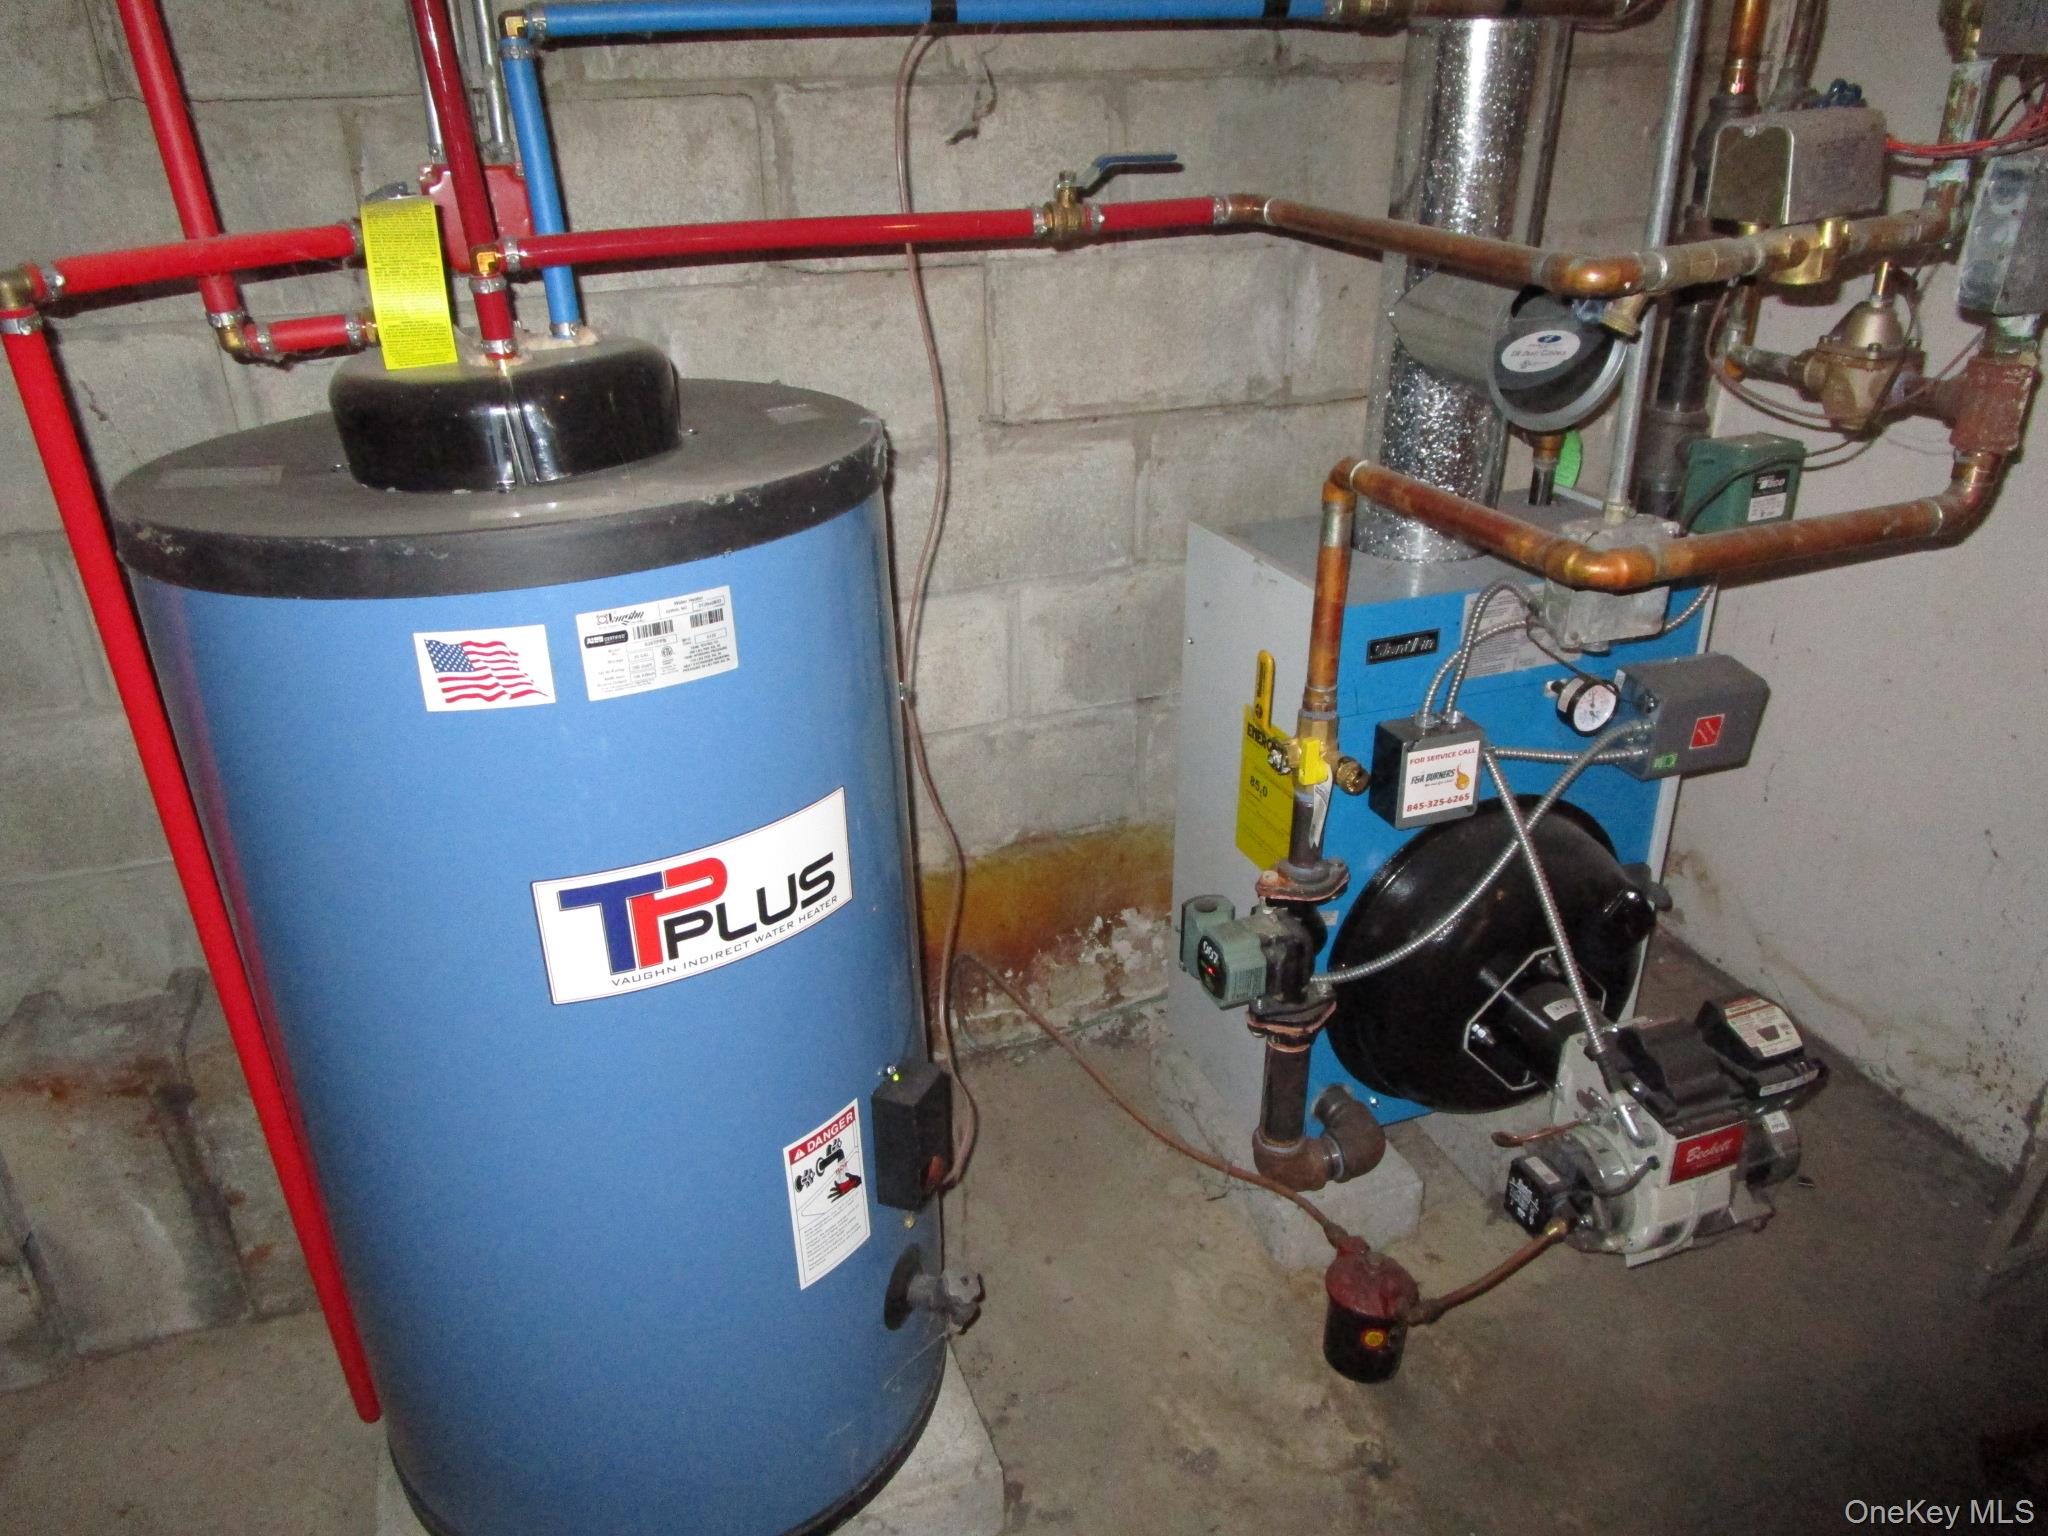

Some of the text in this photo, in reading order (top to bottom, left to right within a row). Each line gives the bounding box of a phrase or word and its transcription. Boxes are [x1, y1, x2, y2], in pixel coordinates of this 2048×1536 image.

[1409, 747, 1477, 766] FOR SERVICE CALL
[1425, 768, 1456, 783] BURNERS
[1406, 792, 1471, 813] 845-325-6265
[666, 851, 837, 961] PLUS
[611, 894, 839, 987] VAUGHN INDIRECT WATER HEATER
[806, 1111, 855, 1152] DANGER
